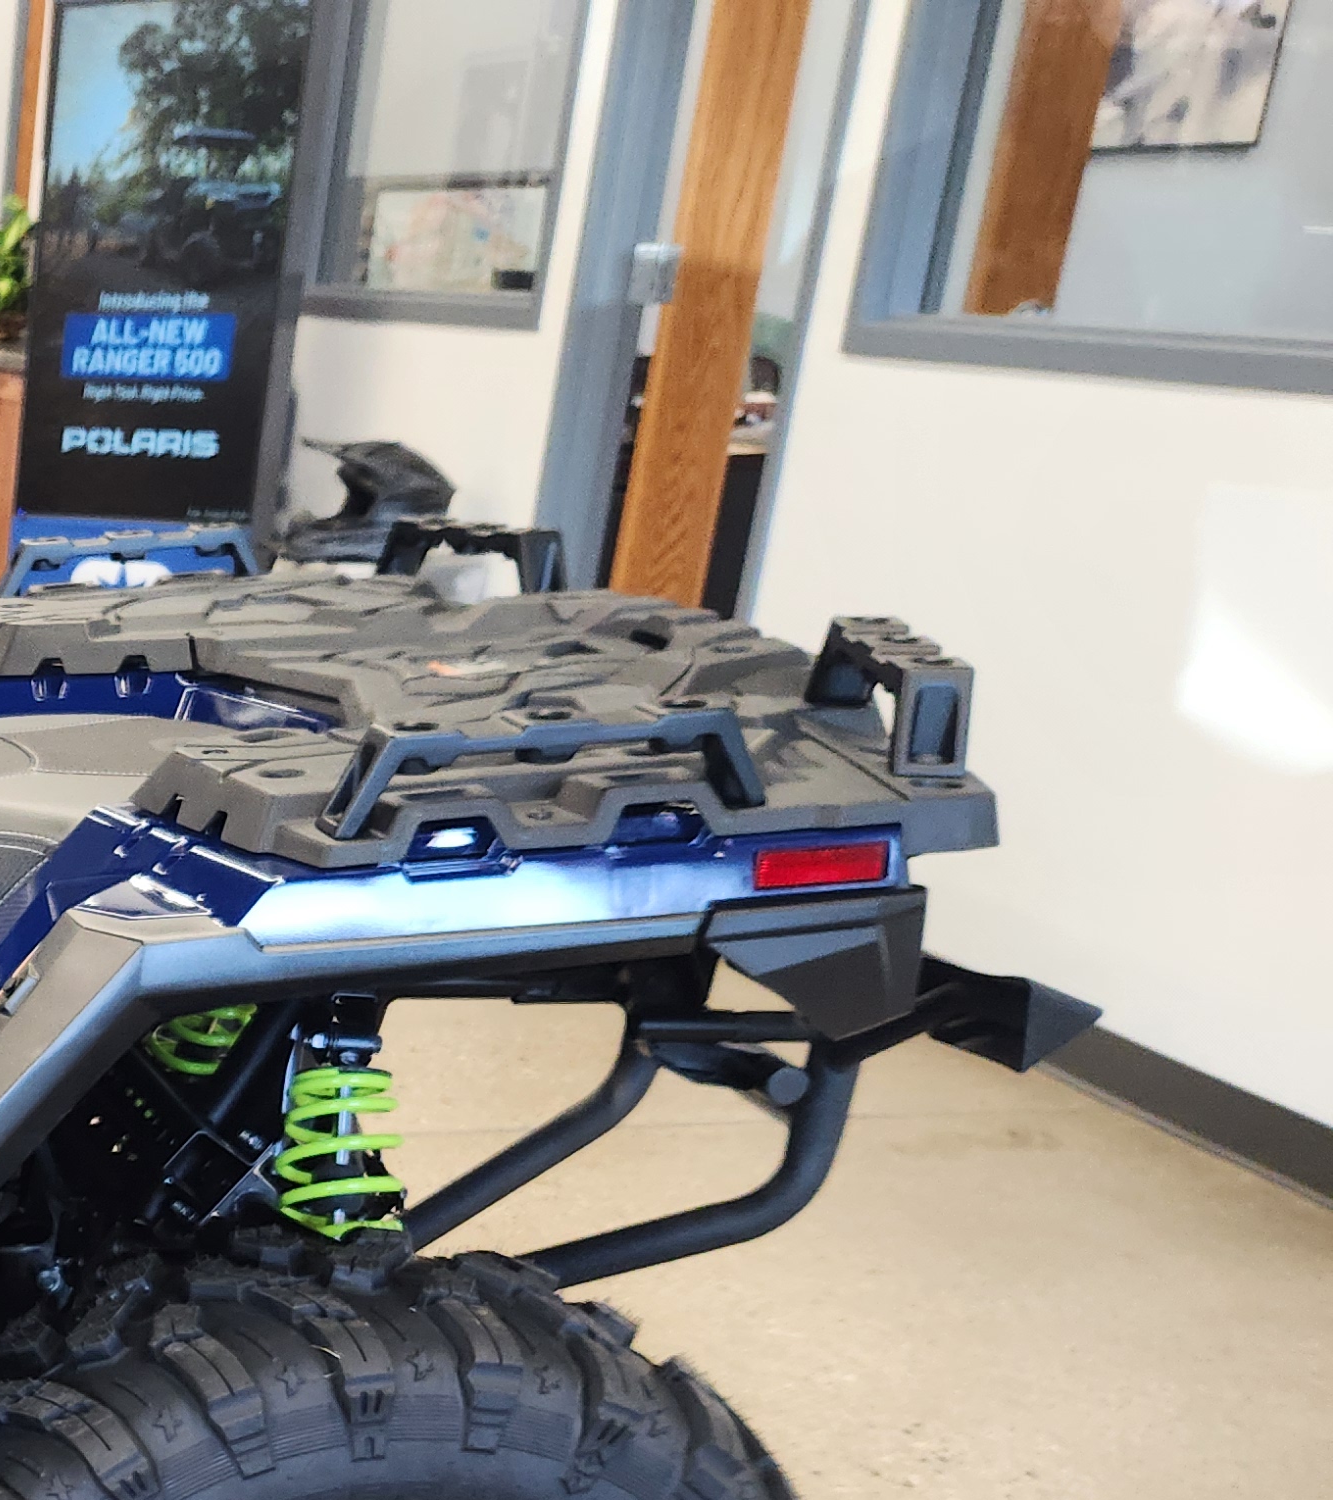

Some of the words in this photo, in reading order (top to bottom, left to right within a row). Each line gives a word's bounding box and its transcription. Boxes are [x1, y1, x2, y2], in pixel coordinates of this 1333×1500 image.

[90, 316, 210, 345] ALL-NEW
[71, 345, 173, 376] RANGER
[60, 424, 221, 459] POLARIS
